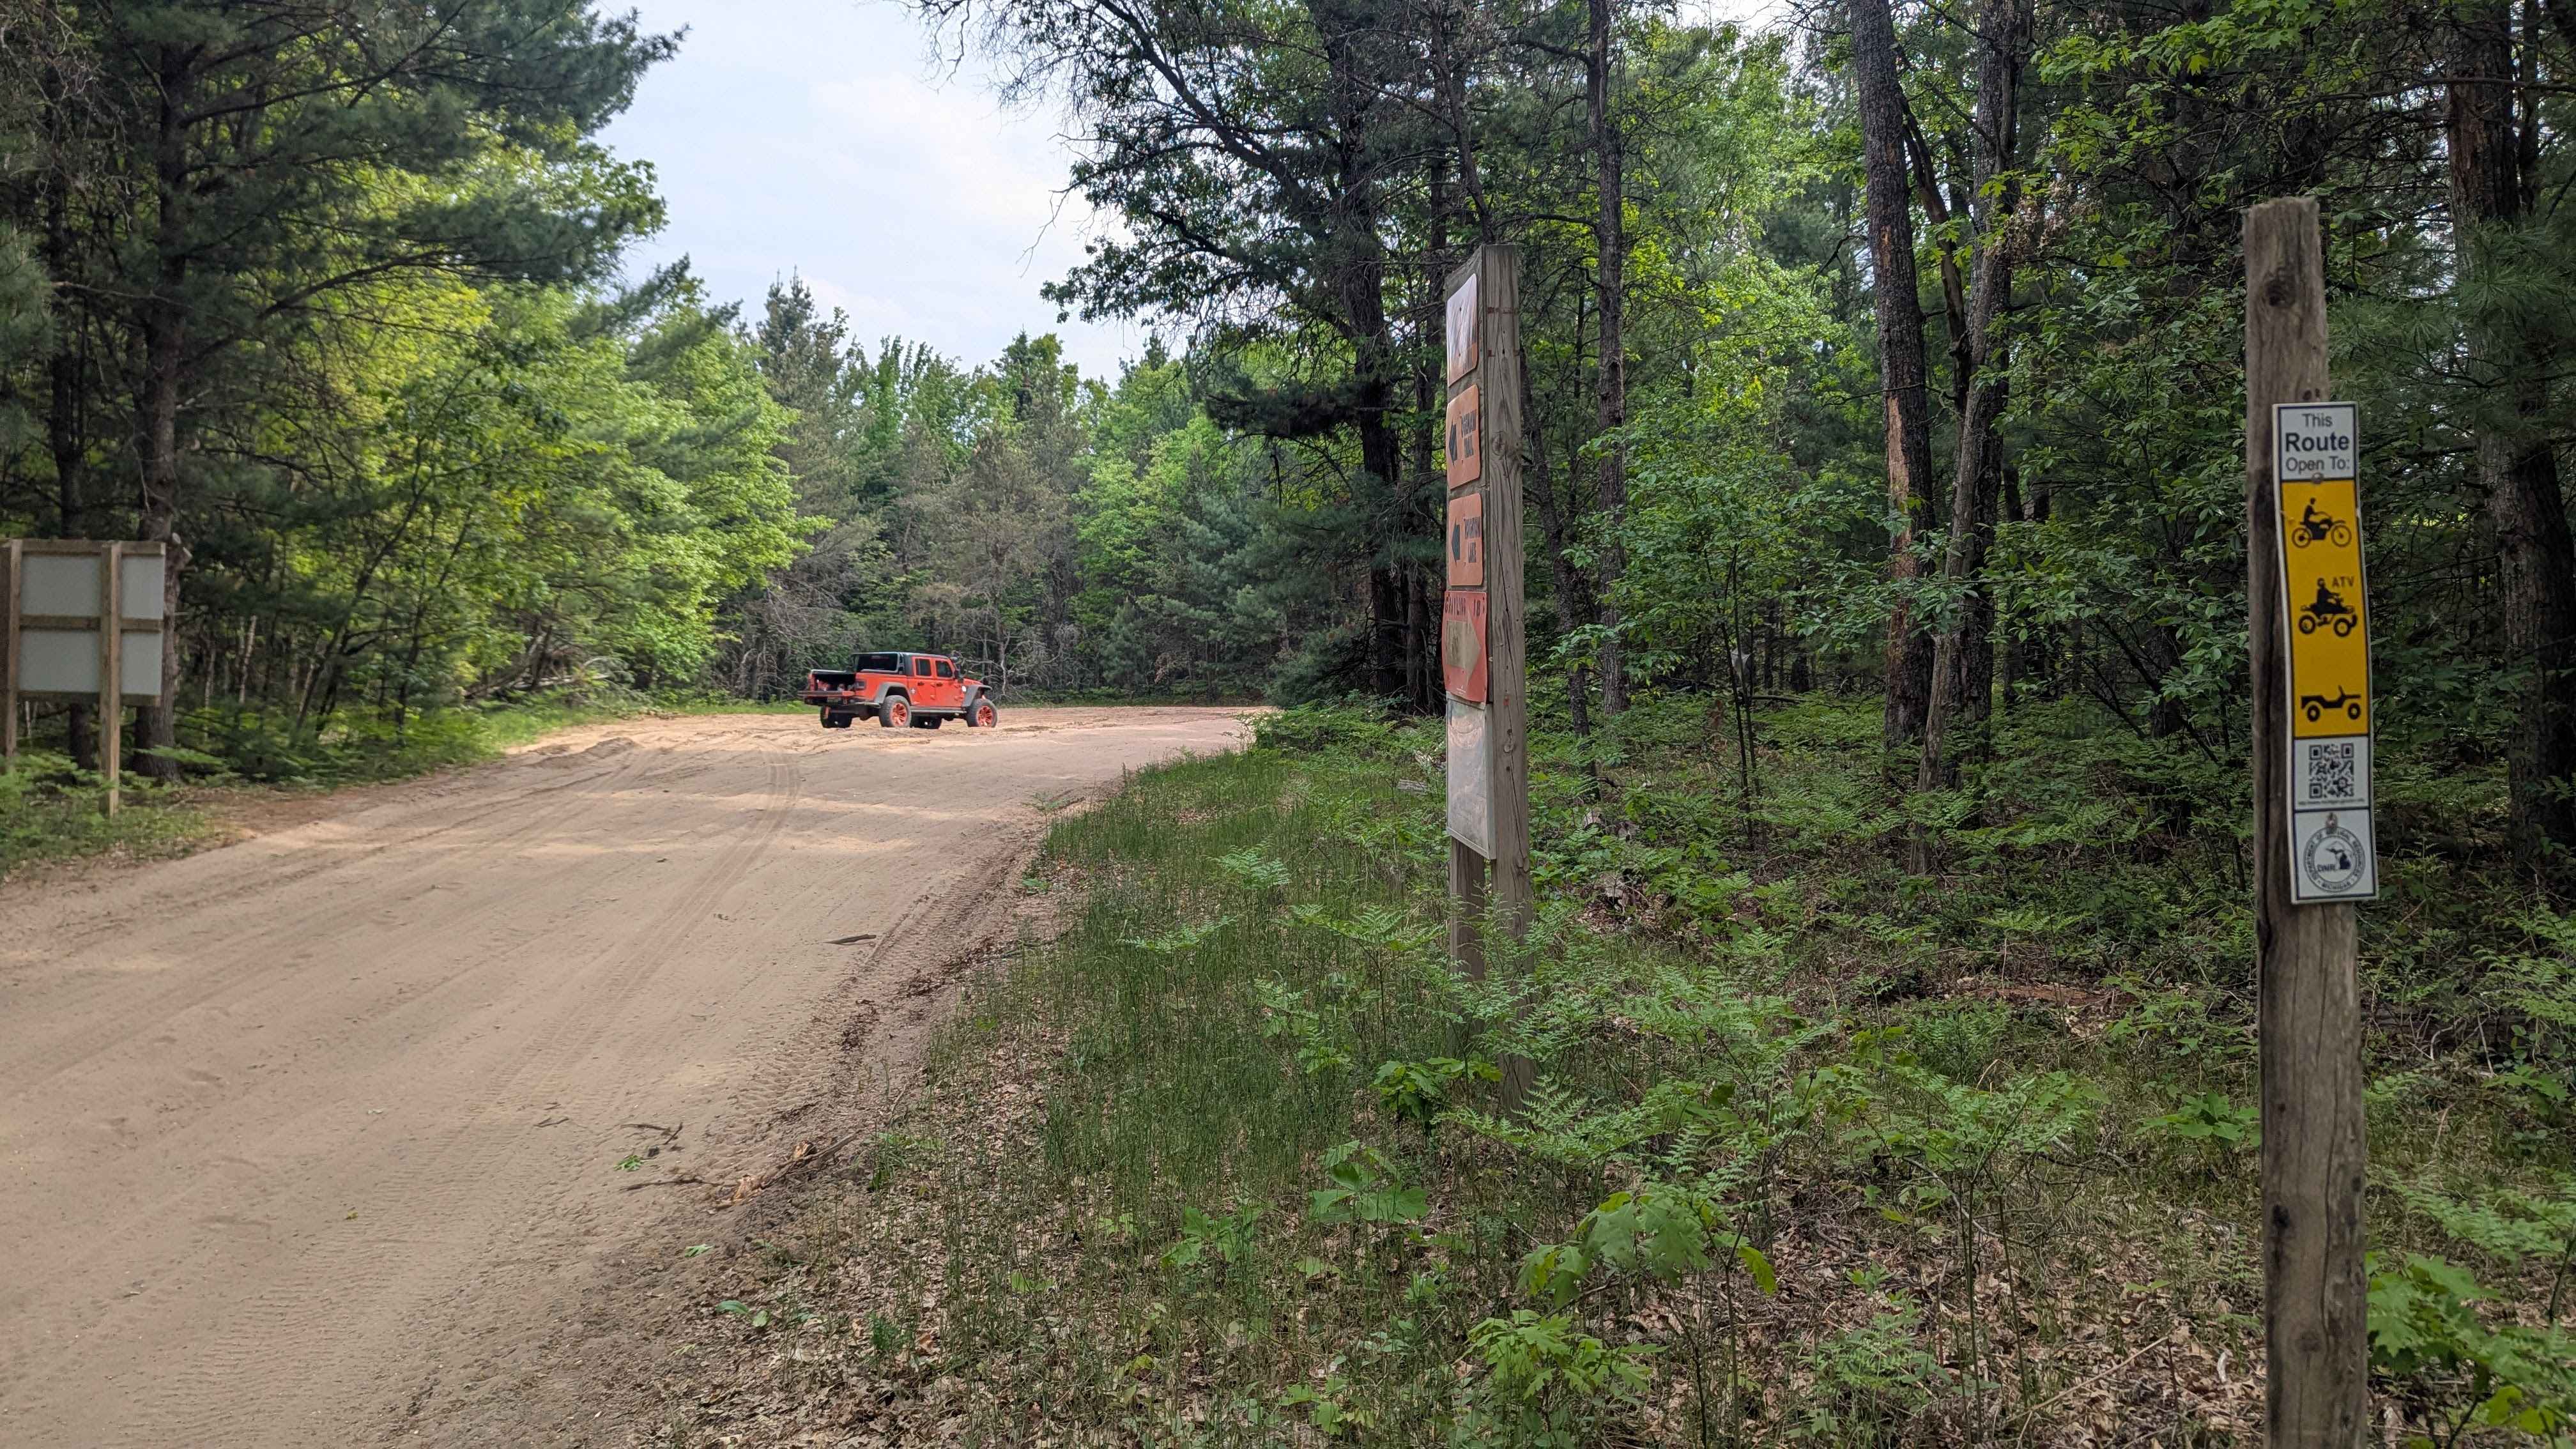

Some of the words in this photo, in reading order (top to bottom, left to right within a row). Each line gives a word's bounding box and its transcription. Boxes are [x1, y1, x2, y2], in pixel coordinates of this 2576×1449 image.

[2301, 413, 2333, 427] This
[2285, 432, 2349, 452] Route
[2285, 457, 2325, 474] Open
[2329, 456, 2350, 470] To:
[1468, 542, 1476, 563] LAKE
[2332, 576, 2355, 587] ATV
